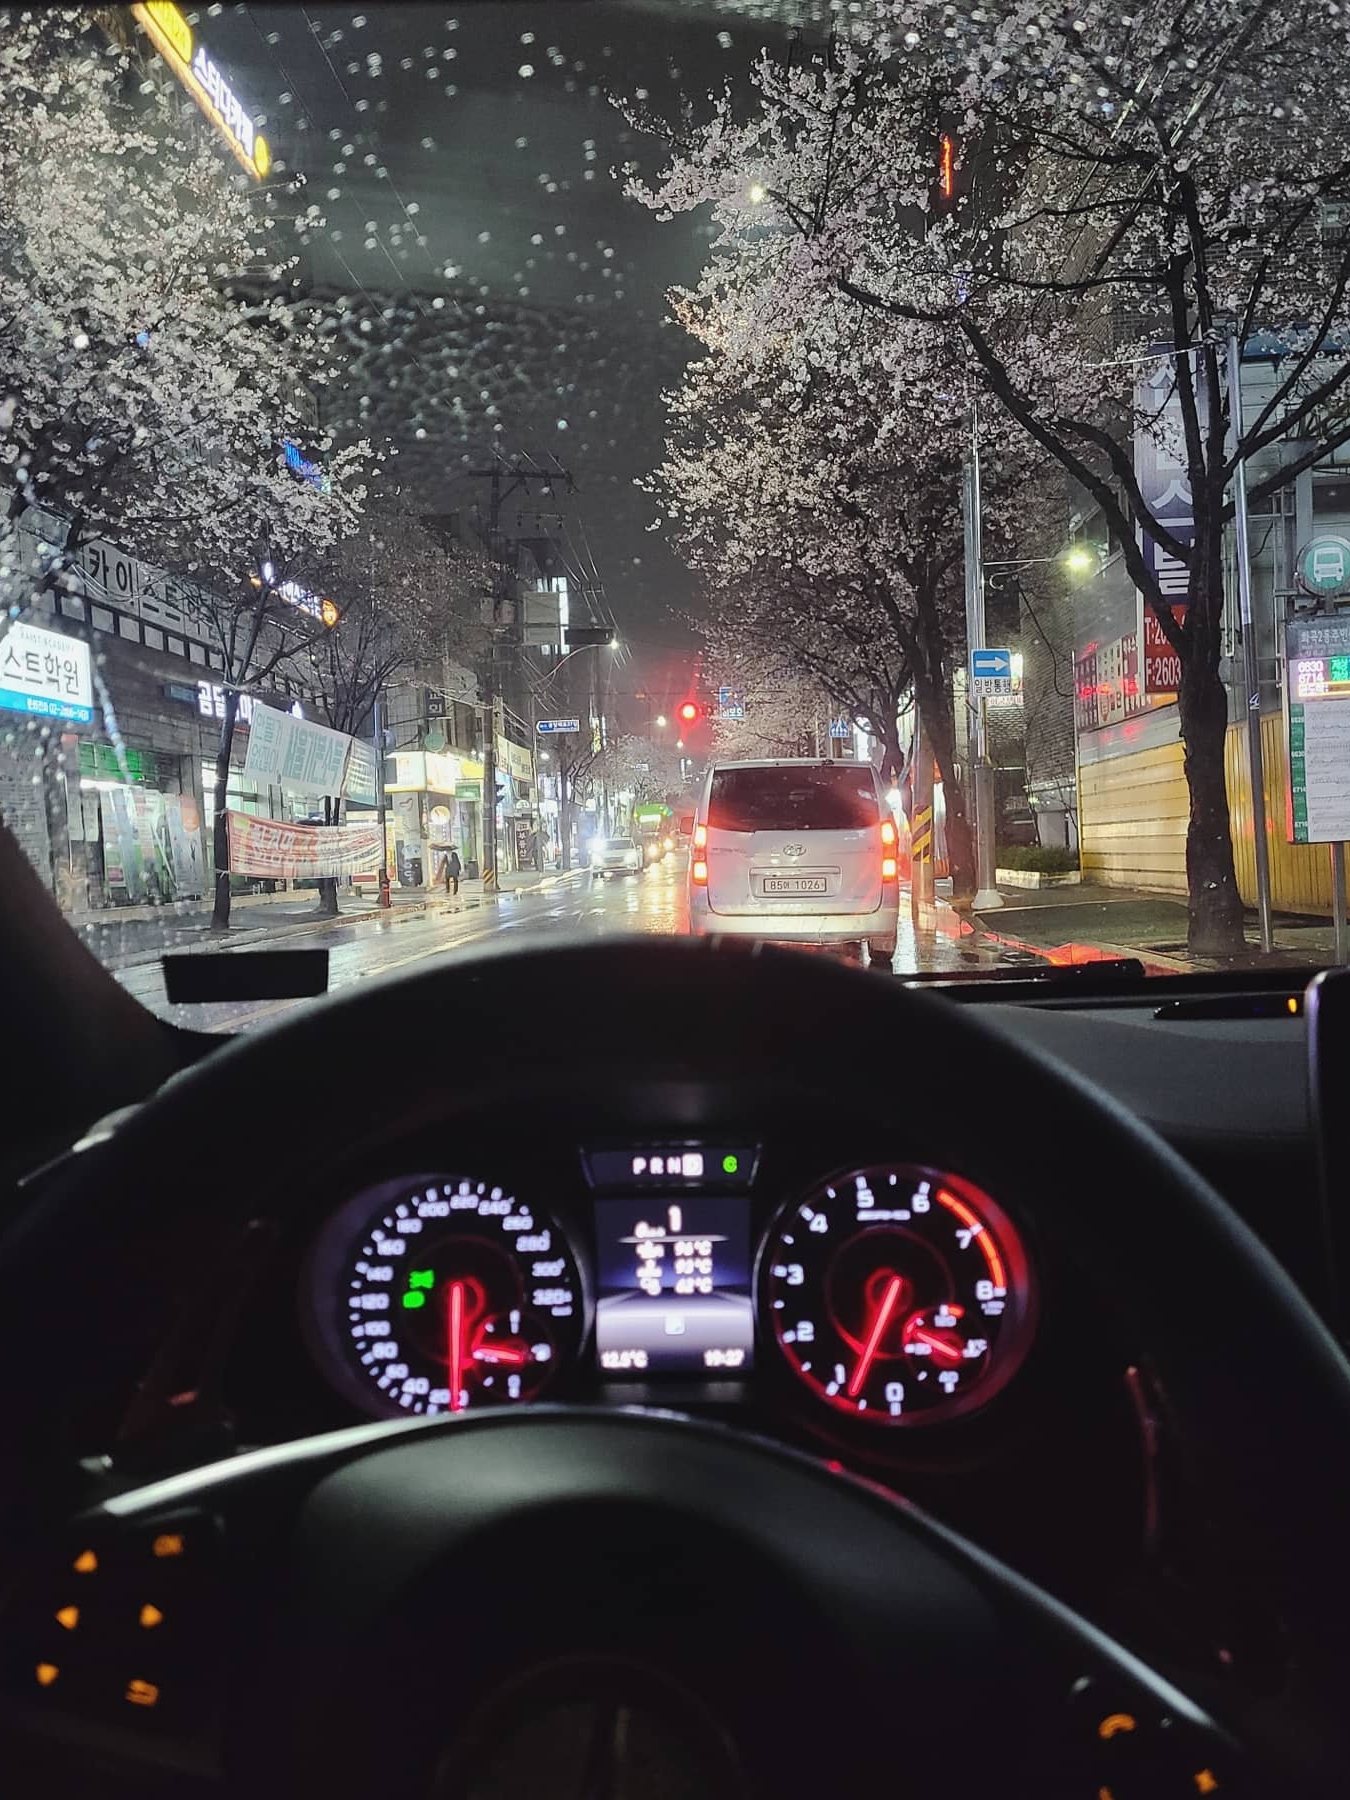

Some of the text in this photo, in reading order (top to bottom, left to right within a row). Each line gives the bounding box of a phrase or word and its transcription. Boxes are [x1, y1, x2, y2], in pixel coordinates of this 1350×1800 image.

[795, 880, 820, 890] 1026
[857, 1188, 874, 1208] 5
[912, 1194, 930, 1213] 6
[809, 1213, 828, 1233] 4
[955, 1229, 972, 1250] 7
[787, 1263, 804, 1285] 3
[976, 1279, 993, 1301] 8
[797, 1320, 815, 1342] 2
[834, 1363, 846, 1385] 1
[885, 1382, 904, 1402] 0
